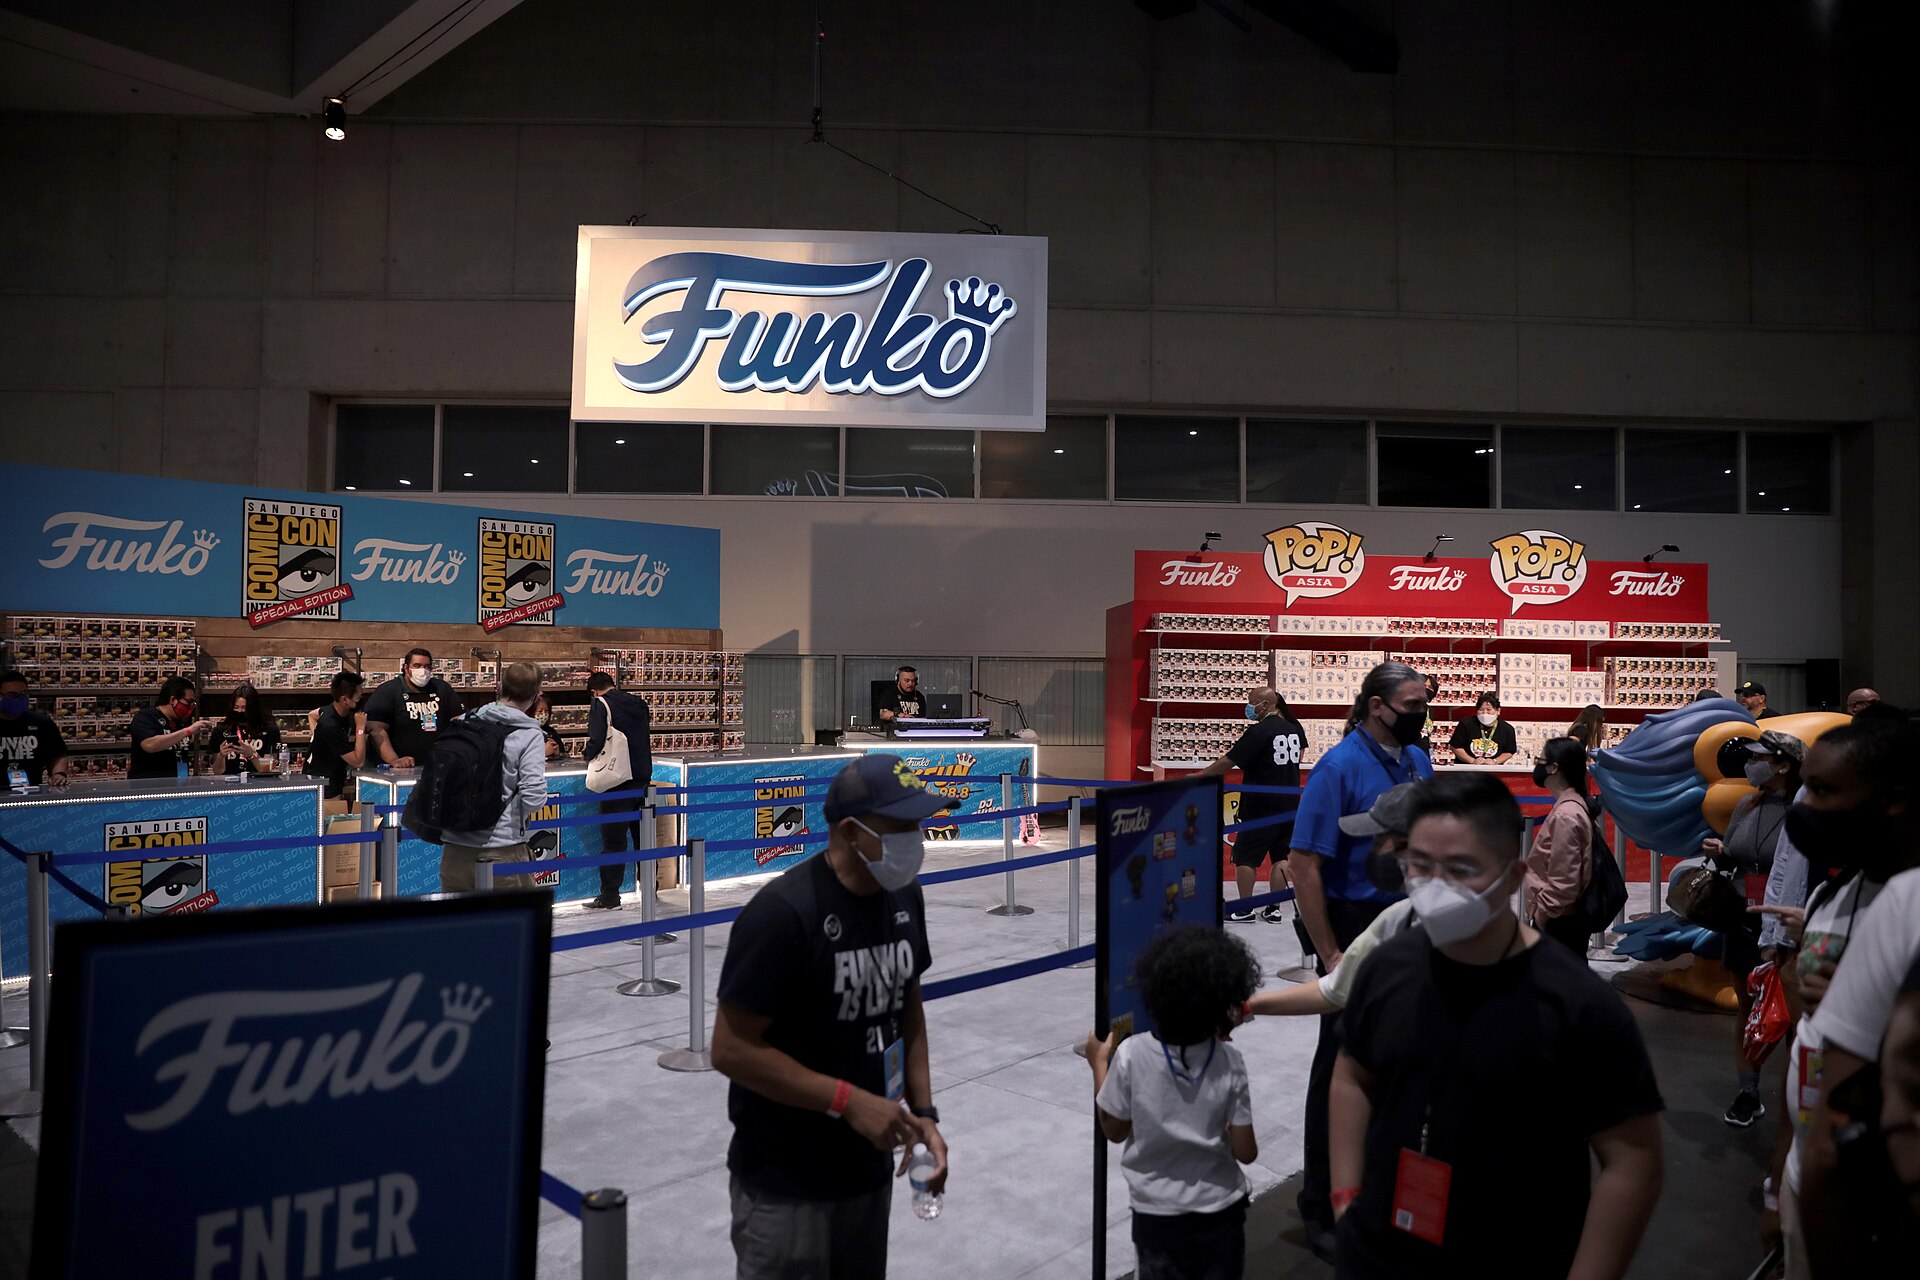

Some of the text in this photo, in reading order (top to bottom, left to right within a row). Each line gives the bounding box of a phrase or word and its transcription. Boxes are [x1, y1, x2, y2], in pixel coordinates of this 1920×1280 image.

[613, 251, 1017, 398] Funko
[248, 502, 338, 518] SAN DIEGO
[281, 515, 336, 547] CON
[482, 521, 553, 535] SAN DIEGO
[38, 511, 220, 576] Funko
[247, 513, 279, 600] COMIC
[507, 533, 551, 561] CON
[1262, 526, 1364, 576] POP!
[350, 538, 467, 586] Funko
[482, 531, 507, 608] COMIC
[1488, 534, 1586, 583] POP!
[564, 549, 670, 598] Funko
[1160, 560, 1241, 588] Funko
[1296, 578, 1333, 587] ASIA
[1389, 565, 1467, 593] Funko
[1609, 571, 1685, 597] Funko
[1521, 585, 1556, 594] ASIA
[254, 588, 348, 622] SPECIAL EDITION
[487, 597, 560, 628] SPECIAL EDITION
[0, 735, 38, 750] UNKO
[1273, 734, 1300, 765] 88
[906, 757, 930, 767] Funko
[689, 773, 705, 784] CIAL
[283, 794, 316, 813] SPECI
[939, 786, 970, 800] 98.8
[979, 798, 994, 810] DJ
[109, 825, 141, 836] SAN
[153, 820, 204, 832] DIEGO
[233, 809, 278, 834] EDITION
[688, 812, 704, 823] TION
[706, 810, 733, 827] EDITION
[736, 808, 754, 822] EDITI
[1110, 806, 1151, 837] Funko
[67, 831, 104, 850] EDITI
[688, 825, 705, 836] CIAL
[706, 820, 736, 840] SPECIAL
[234, 858, 282, 884] SPECIAL
[283, 858, 316, 879] SPECI
[398, 854, 422, 869] CIAL
[110, 836, 142, 918] OMC
[398, 868, 421, 883] TION
[233, 876, 278, 902] EDITION
[174, 894, 214, 916] DITION
[836, 990, 859, 1021] IS
[122, 971, 494, 1133] Funko
[193, 1172, 419, 1280] ENTER
